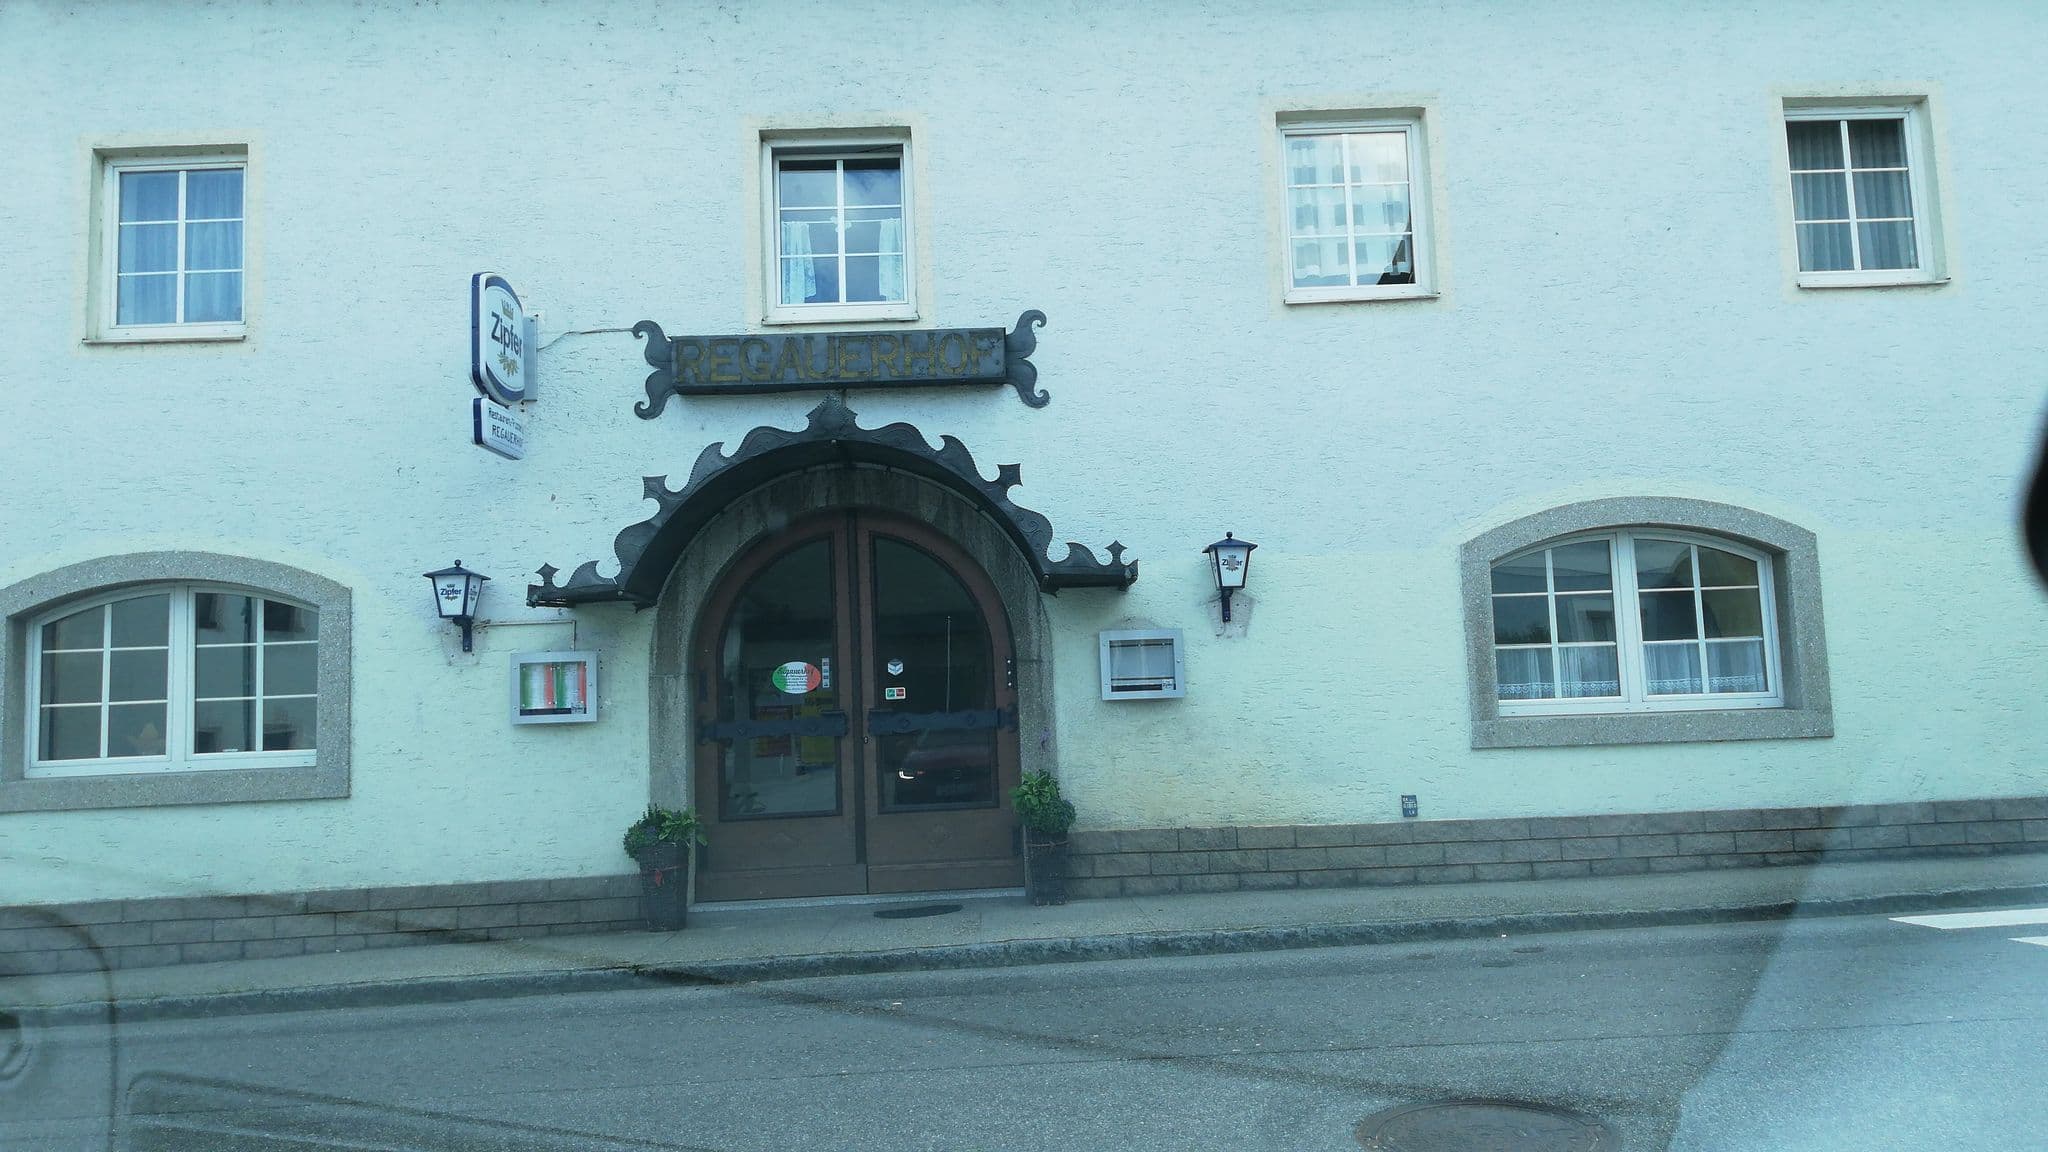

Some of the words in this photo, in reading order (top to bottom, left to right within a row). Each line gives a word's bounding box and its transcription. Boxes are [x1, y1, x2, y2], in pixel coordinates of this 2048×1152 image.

[490, 311, 522, 359] Zipfer
[676, 332, 1000, 384] REGAUERHOF
[1221, 558, 1243, 567] Zier
[440, 588, 462, 597] Zipfer
